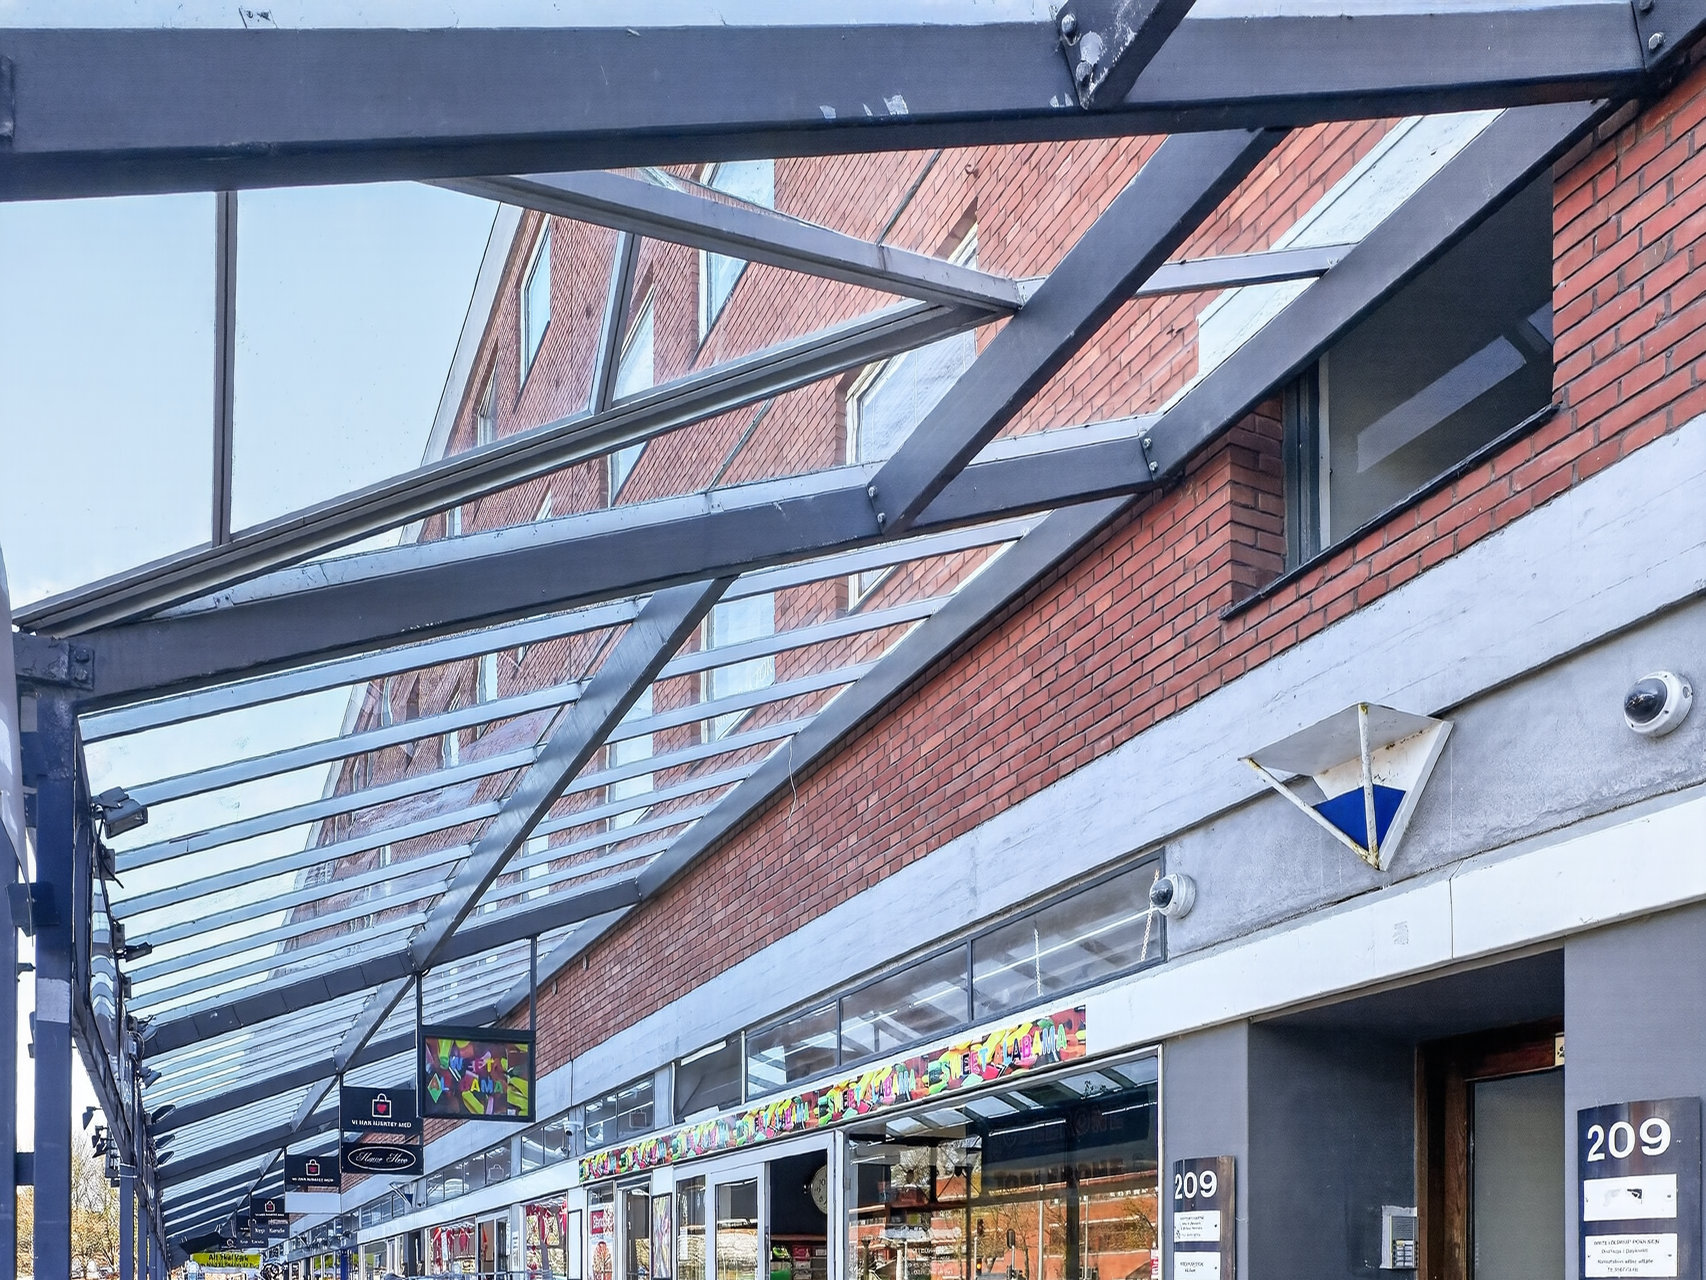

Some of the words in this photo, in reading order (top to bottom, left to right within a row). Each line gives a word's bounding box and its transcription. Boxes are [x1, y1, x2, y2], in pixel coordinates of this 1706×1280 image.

[994, 1023, 1067, 1065] ALABAMA
[1587, 1117, 1671, 1162] 209
[1174, 1170, 1217, 1200] 209
